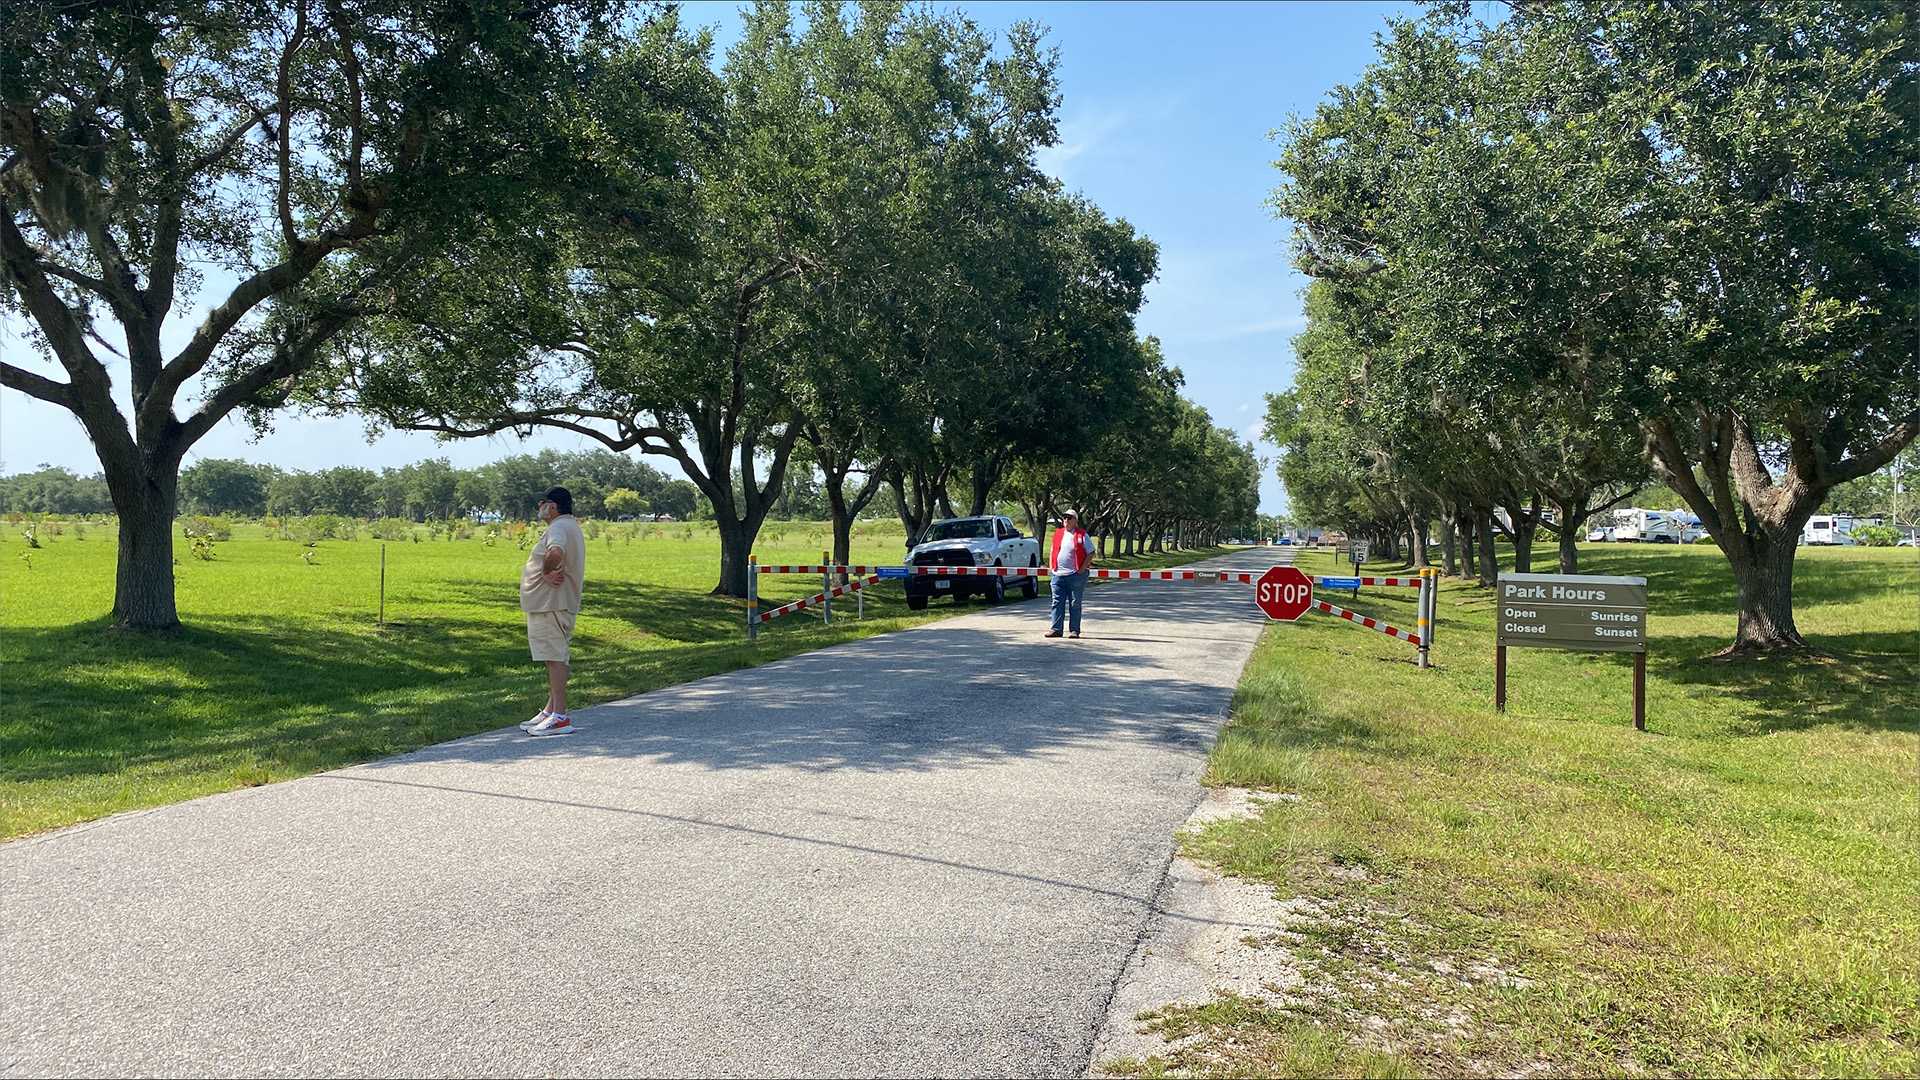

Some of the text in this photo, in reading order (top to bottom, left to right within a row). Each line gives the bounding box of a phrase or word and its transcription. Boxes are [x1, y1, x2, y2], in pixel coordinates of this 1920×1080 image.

[1352, 552, 1364, 561] 15
[1260, 582, 1309, 604] STOP
[1505, 585, 1606, 601] Park Hours
[1504, 608, 1638, 622] Open Sunrise
[1504, 623, 1638, 637] Closed Sunset
